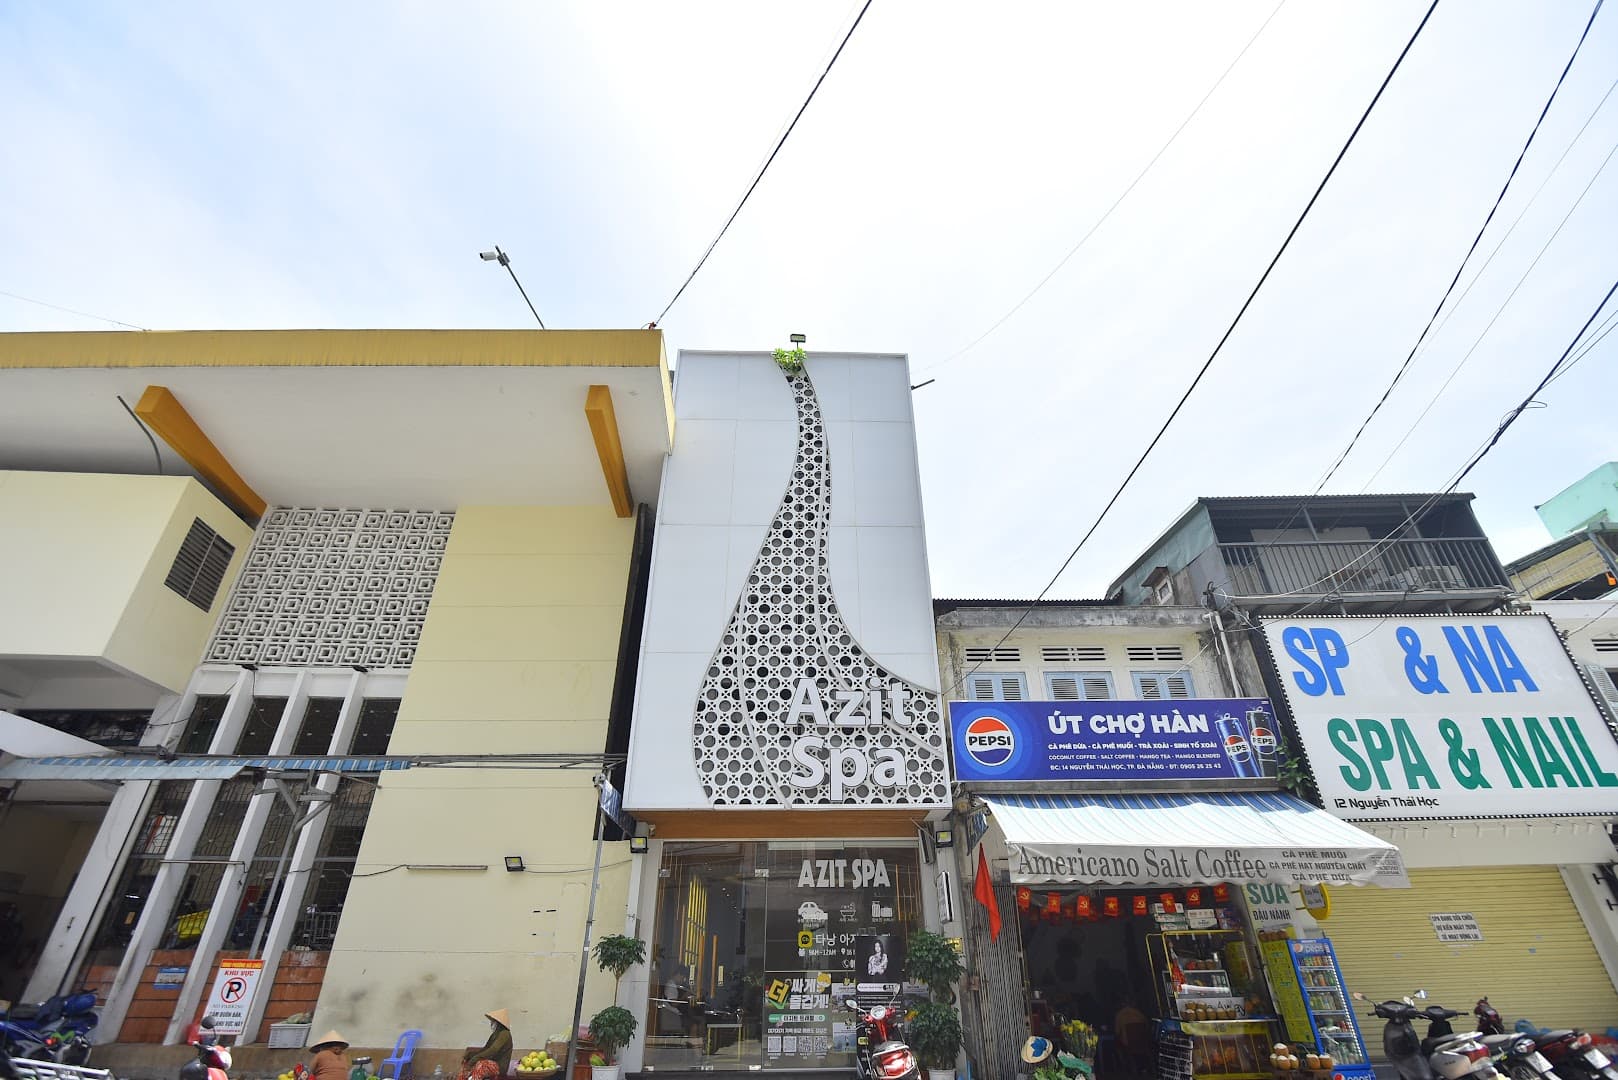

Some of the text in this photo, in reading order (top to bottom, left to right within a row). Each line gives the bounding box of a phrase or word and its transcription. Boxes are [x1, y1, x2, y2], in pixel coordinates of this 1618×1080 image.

[1282, 625, 1540, 696] SP & NA
[785, 677, 912, 726] Azit
[1048, 709, 1209, 738] ÚT CHỢ HÀN
[968, 735, 1012, 746] PEPSI
[1327, 717, 1618, 792] SPA & NAIL
[789, 736, 907, 801] Spa
[1334, 795, 1440, 810] 12 Nguyễn Thái Học
[798, 859, 891, 889] AZIT SPA
[1018, 846, 1268, 879] Americano Salt Coffee
[768, 979, 790, 1003] 더
[790, 978, 817, 993] 싸게
